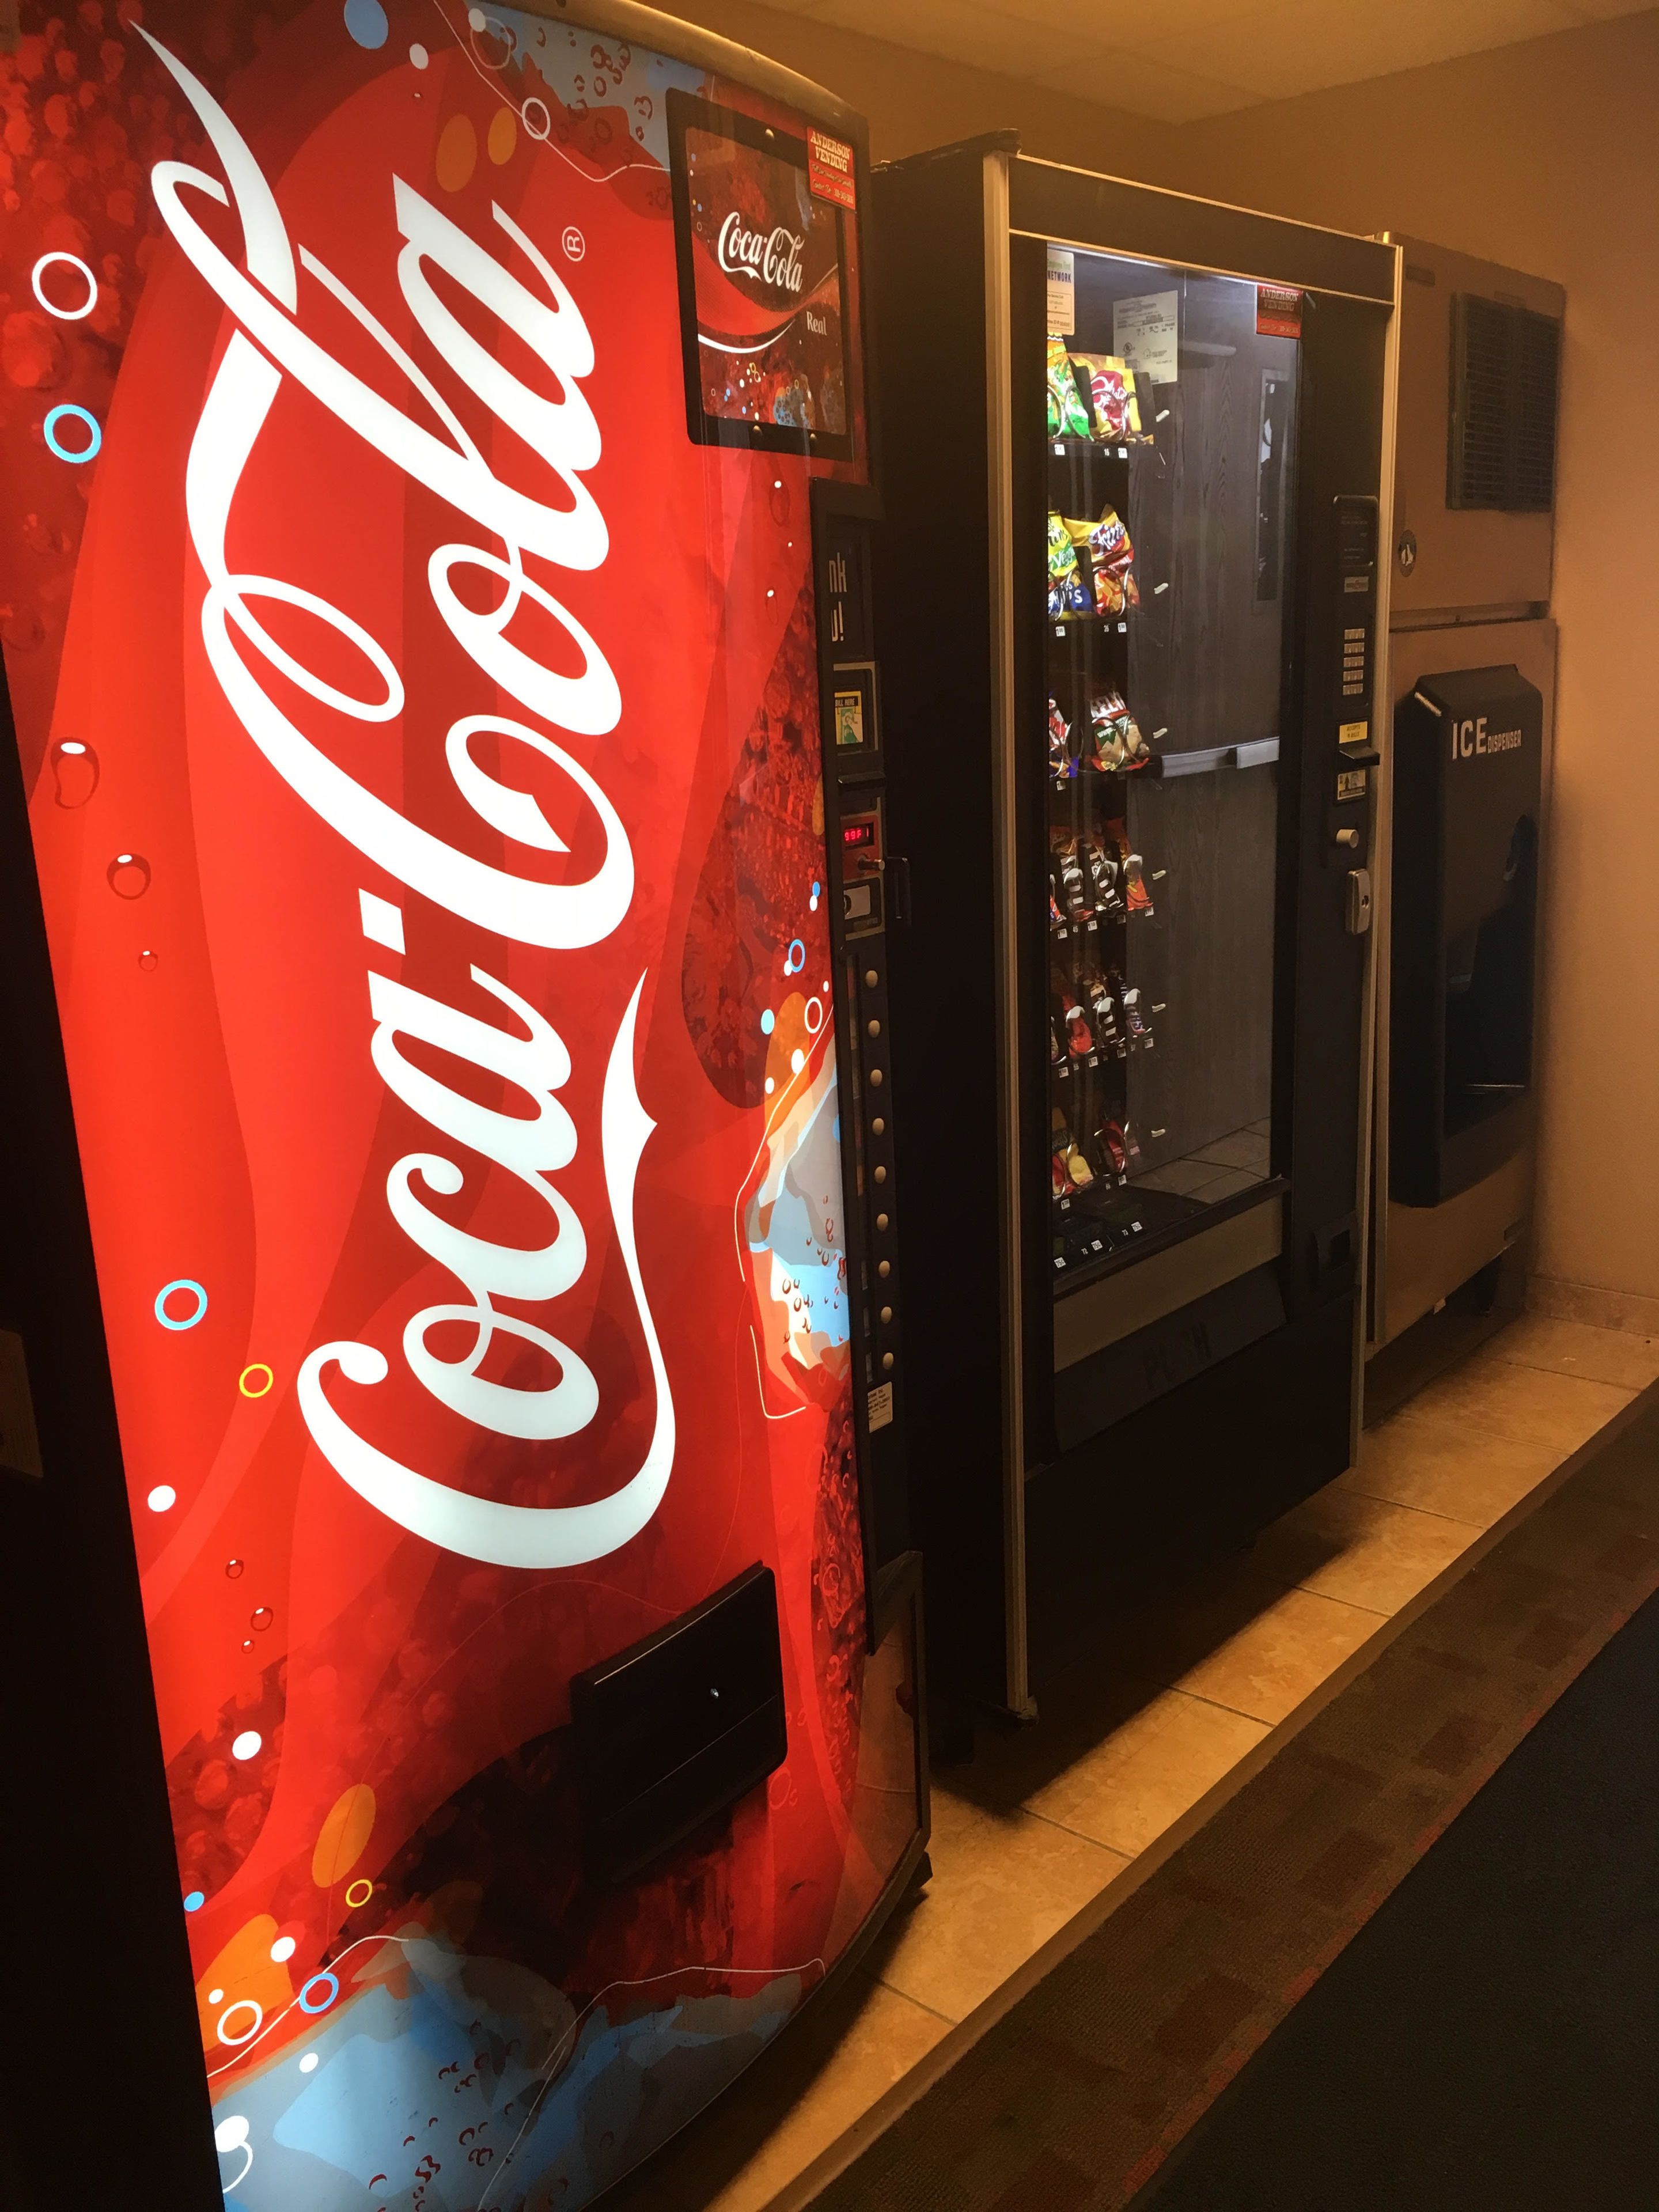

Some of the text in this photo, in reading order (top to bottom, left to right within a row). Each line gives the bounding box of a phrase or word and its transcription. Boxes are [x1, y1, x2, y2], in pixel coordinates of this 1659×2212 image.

[810, 130, 850, 161] ANDERSON
[815, 145, 847, 173] VENDING
[718, 211, 805, 293] Coca-Cola
[1260, 288, 1299, 301] ANDERSON
[1264, 299, 1295, 312] VENDING
[806, 311, 827, 336] Real
[1452, 717, 1522, 760] ICE DISPENSER
[128, 20, 675, 1569] Coca-Cola
